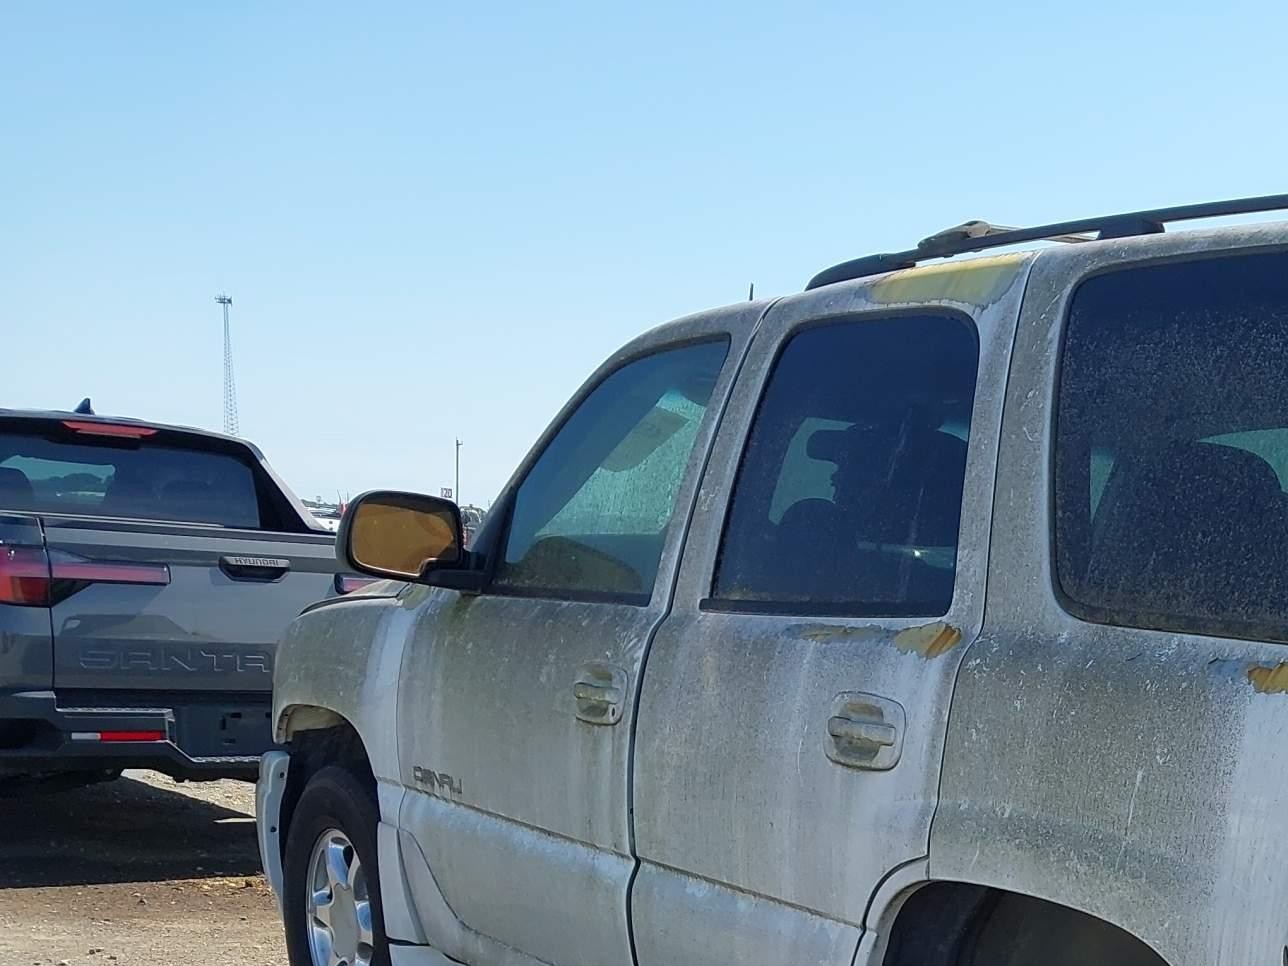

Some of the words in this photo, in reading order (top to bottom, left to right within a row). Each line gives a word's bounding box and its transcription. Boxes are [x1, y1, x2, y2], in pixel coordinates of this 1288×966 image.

[234, 557, 279, 567] HYUNDAI
[79, 649, 271, 673] SANTA
[413, 766, 463, 795] DENALI
